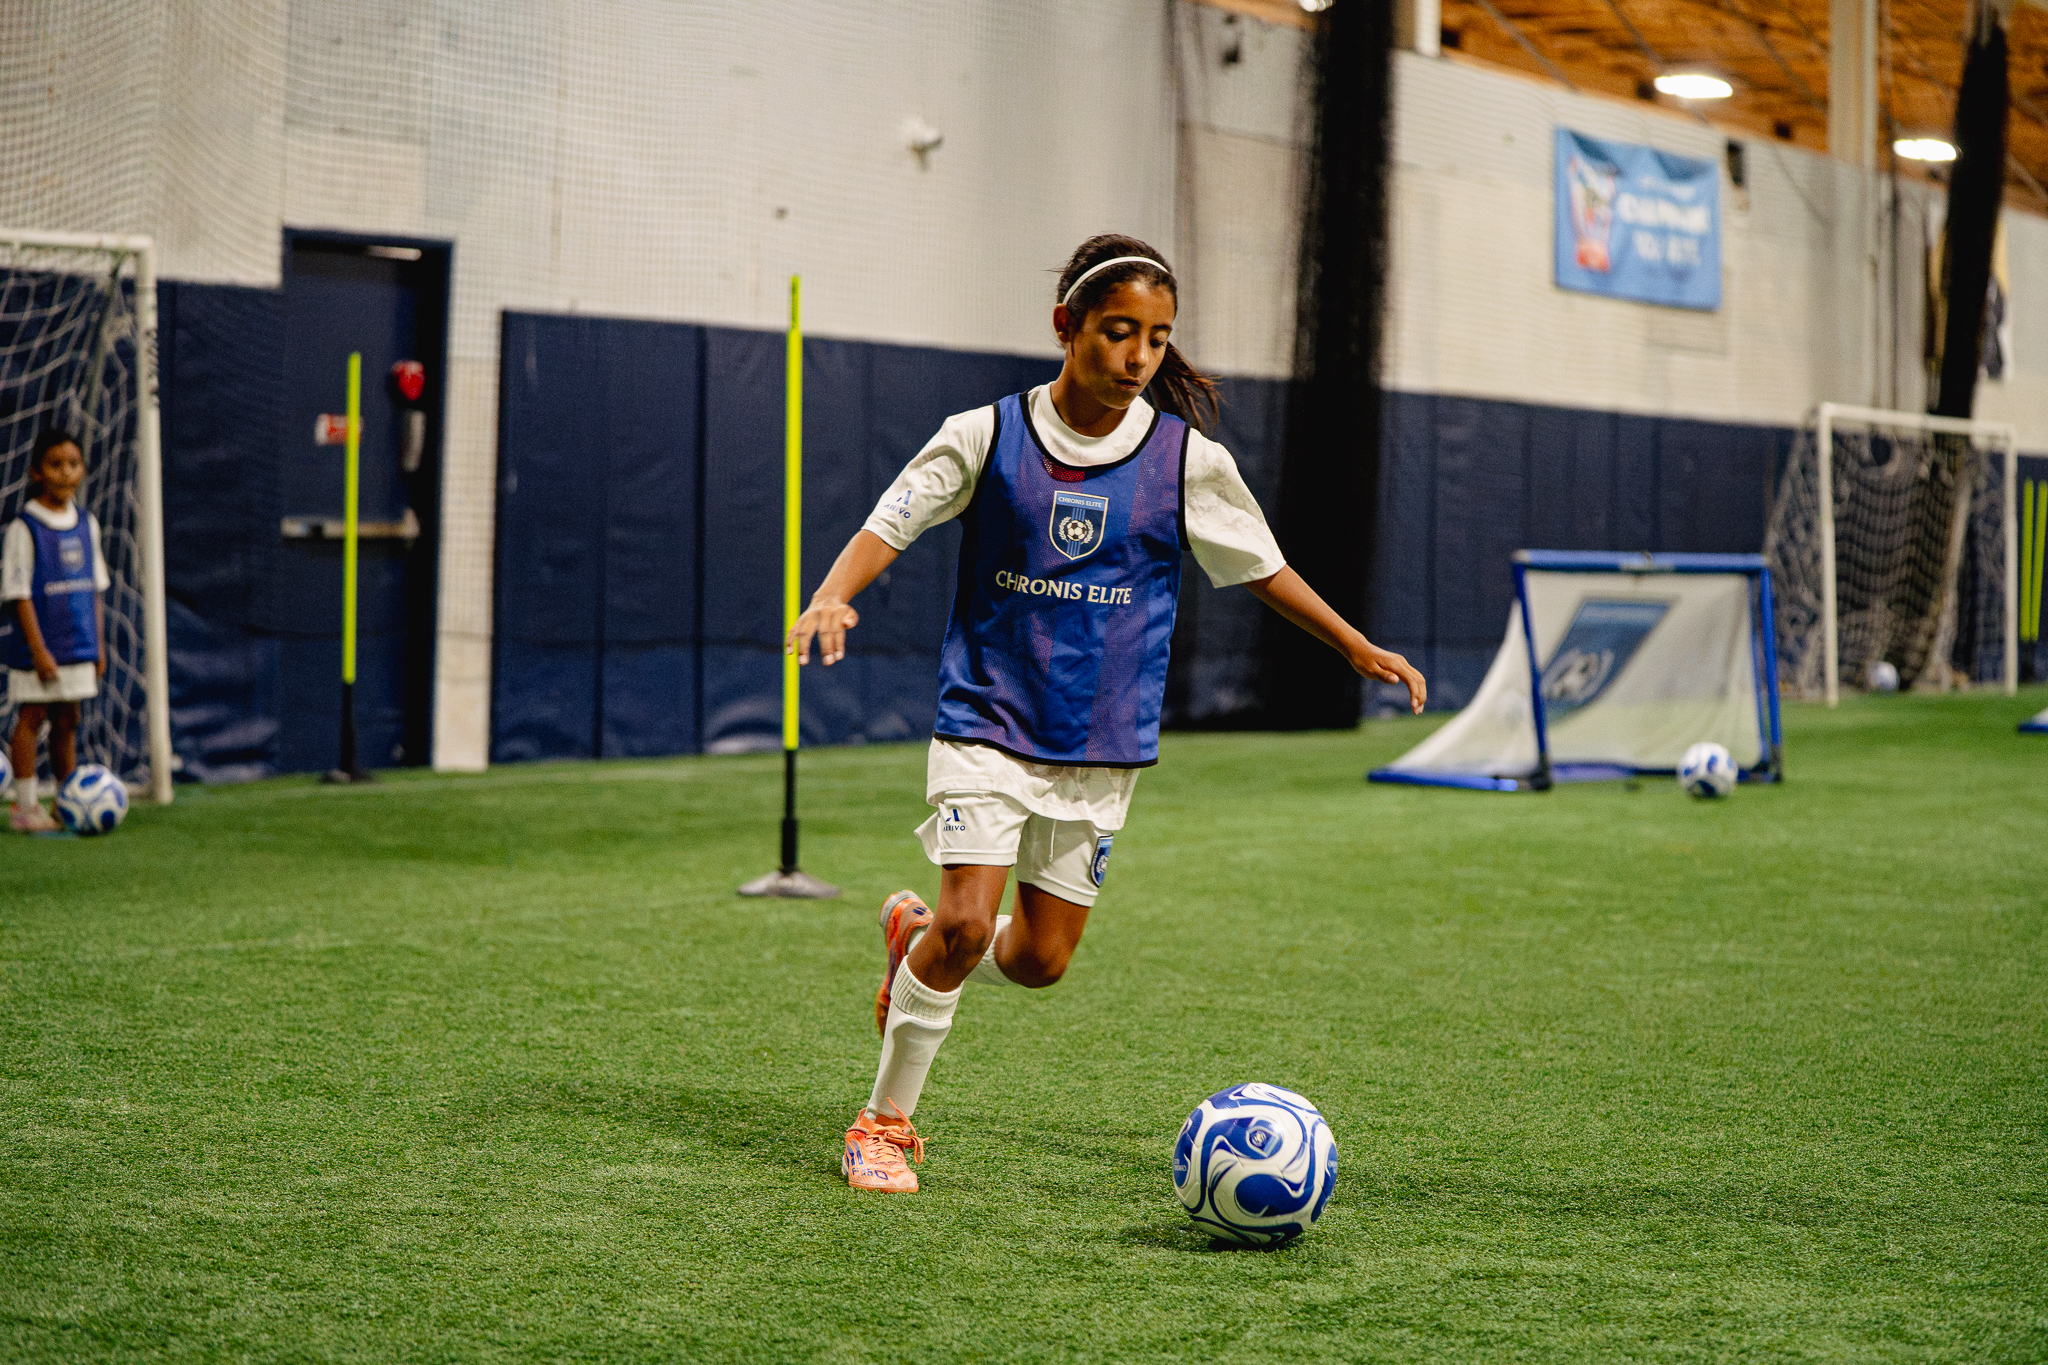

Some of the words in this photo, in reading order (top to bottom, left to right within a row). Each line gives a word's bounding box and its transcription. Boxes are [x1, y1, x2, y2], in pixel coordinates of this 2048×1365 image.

[1058, 496, 1085, 506] CHRONIS
[1085, 500, 1103, 509] ELITE
[995, 570, 1083, 600] CHRONIS
[1087, 584, 1132, 605] ELITE
